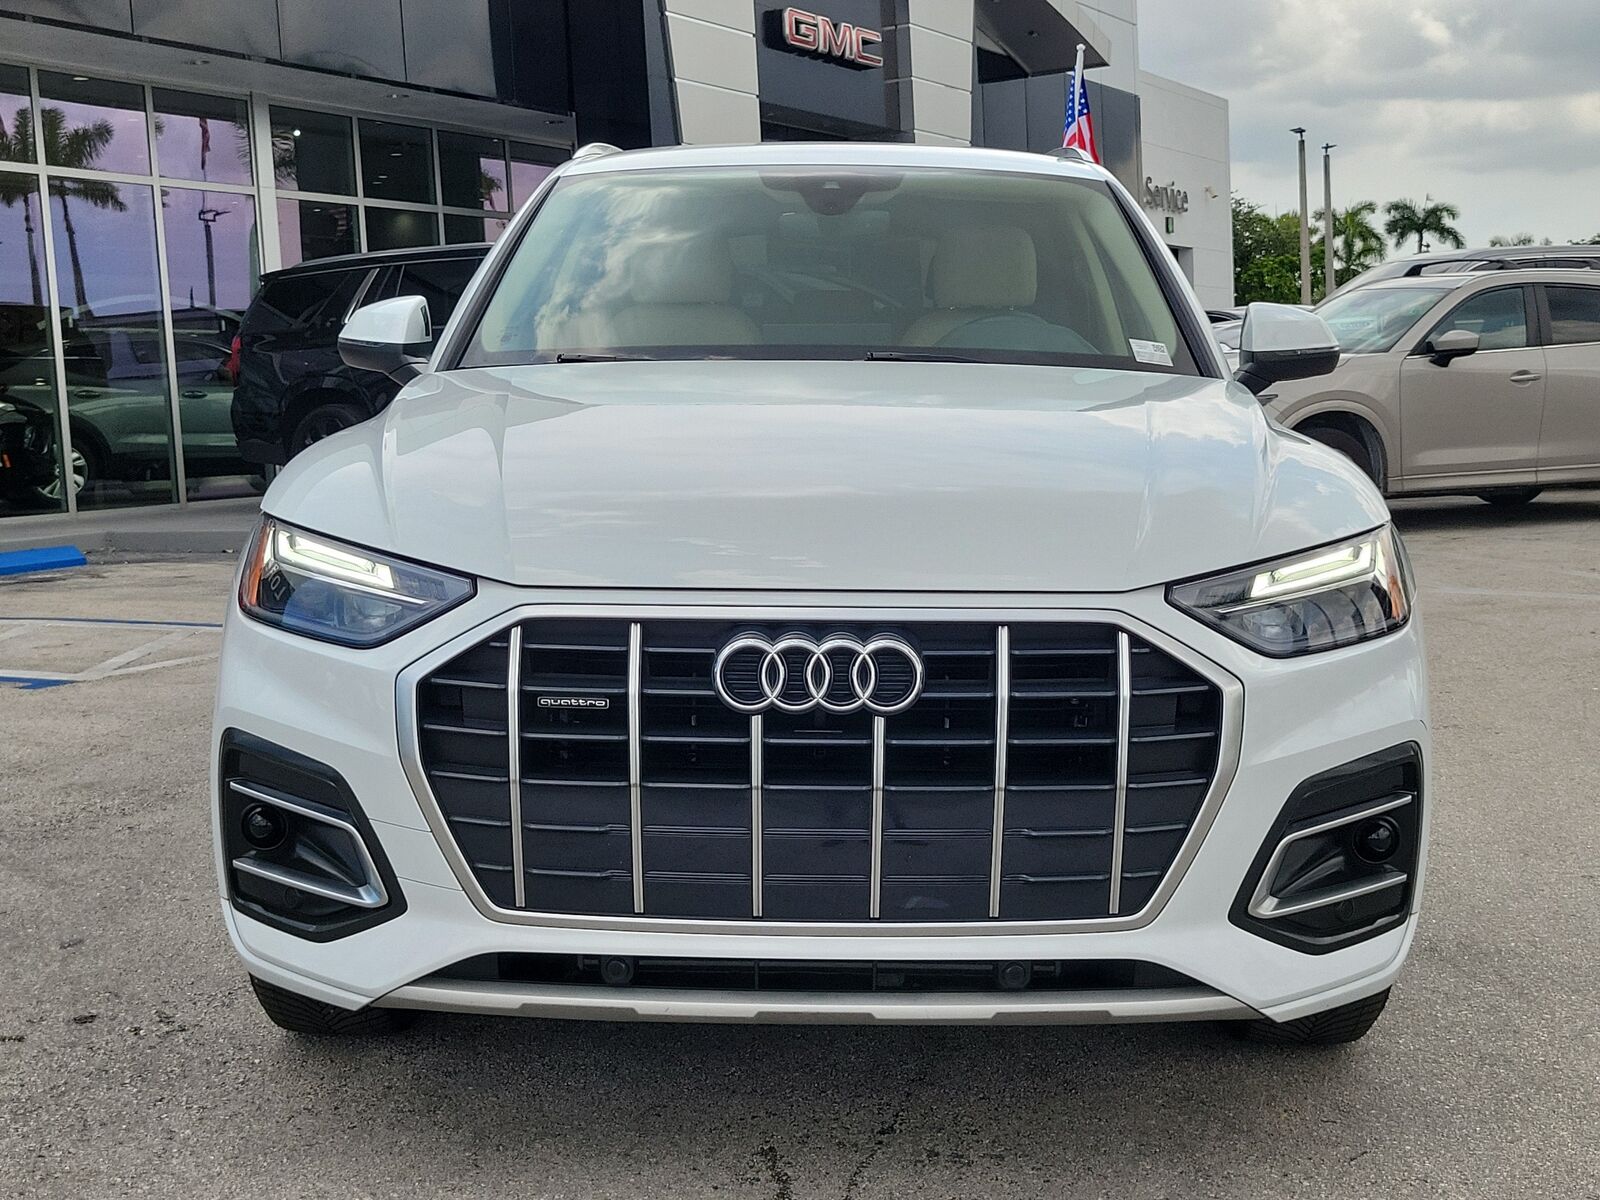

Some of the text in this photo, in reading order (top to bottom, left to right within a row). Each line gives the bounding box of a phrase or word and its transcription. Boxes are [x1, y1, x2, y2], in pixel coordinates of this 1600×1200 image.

[784, 7, 883, 66] GMC
[1145, 176, 1188, 213] Service
[539, 697, 607, 708] quattro
